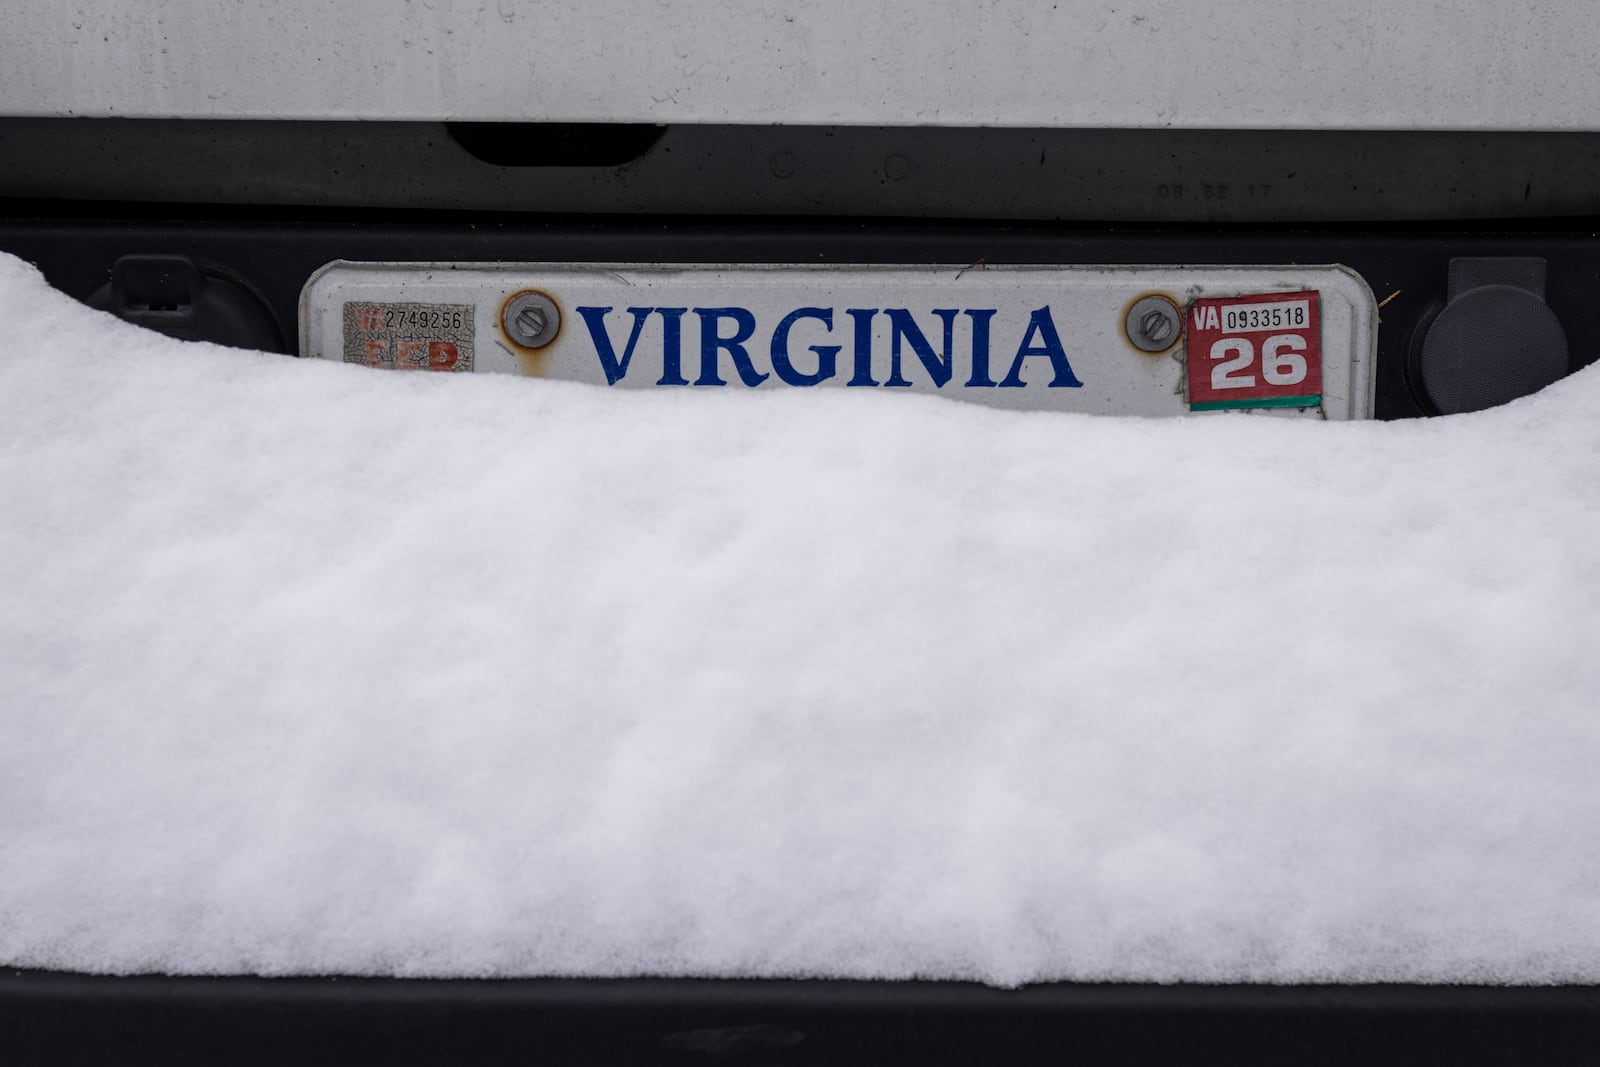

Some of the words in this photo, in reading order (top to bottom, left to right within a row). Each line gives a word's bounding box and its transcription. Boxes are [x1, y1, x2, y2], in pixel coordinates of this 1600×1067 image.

[386, 310, 462, 329] 2749256
[1193, 305, 1220, 331] VA
[1227, 306, 1304, 330] 0933518
[575, 304, 1085, 389] VIRGINIA
[1209, 333, 1308, 390] 26
